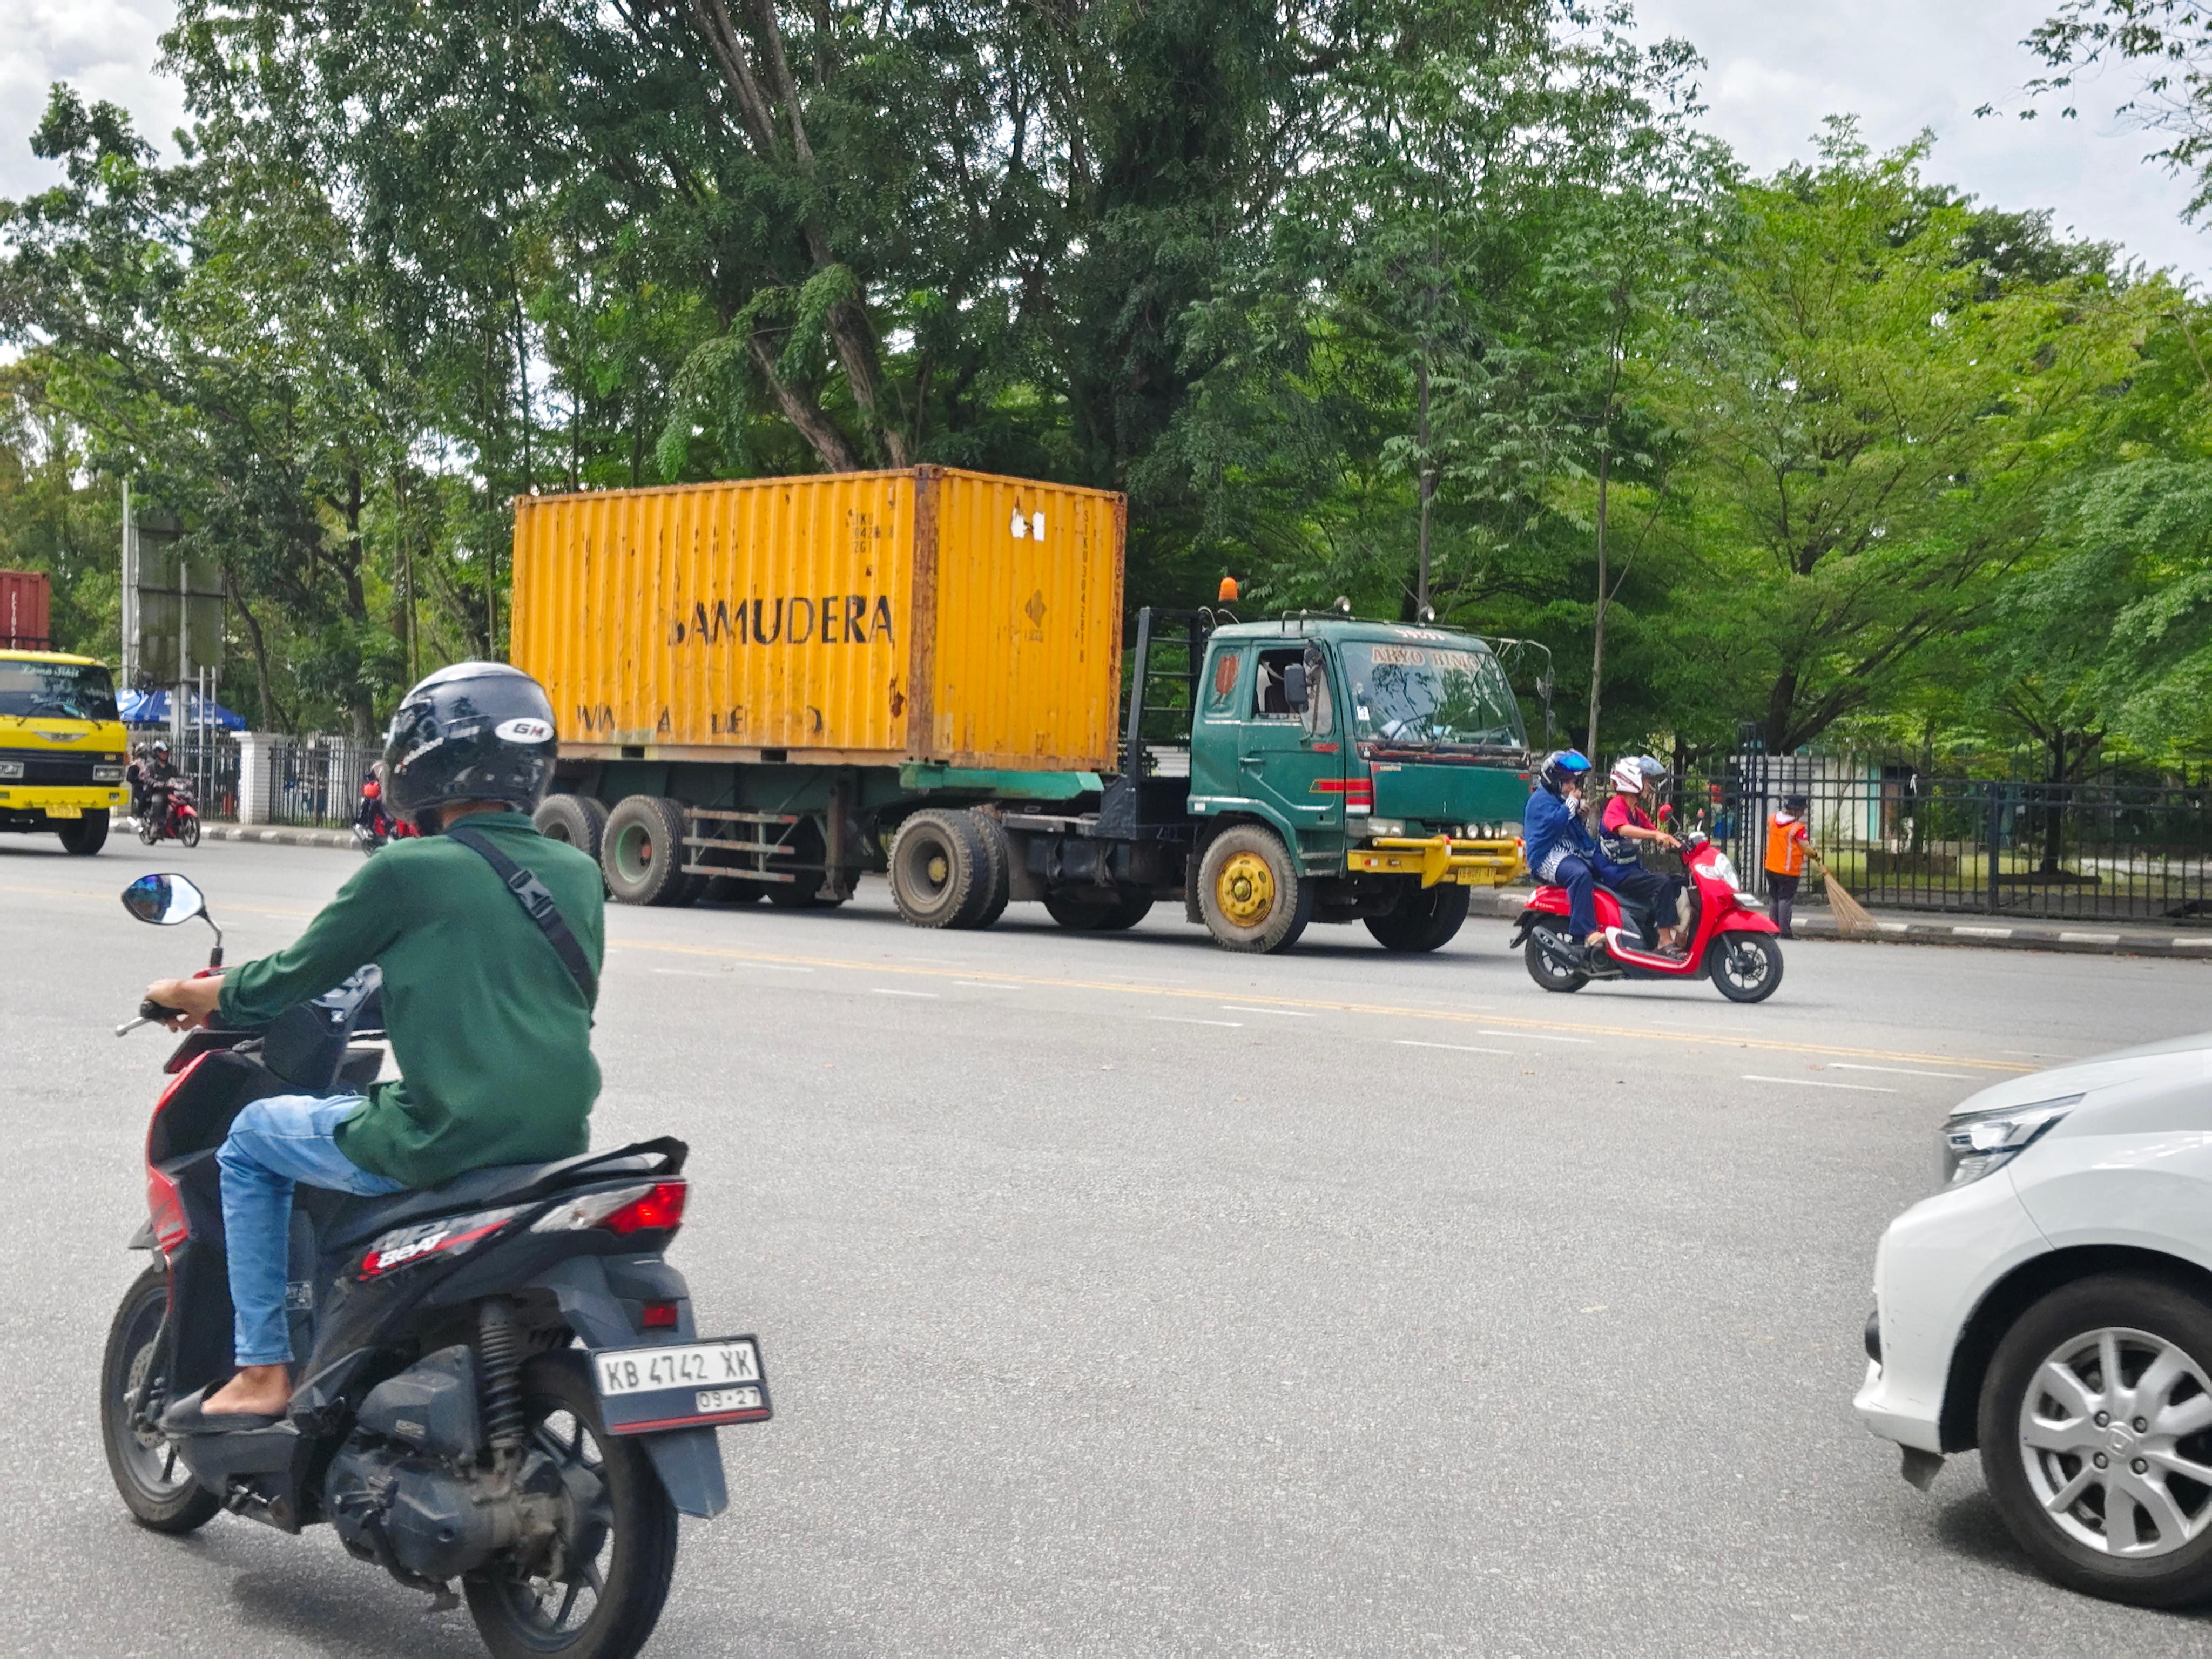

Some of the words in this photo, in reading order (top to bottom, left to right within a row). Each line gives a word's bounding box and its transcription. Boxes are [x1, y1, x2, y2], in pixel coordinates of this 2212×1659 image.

[512, 723, 544, 737] GM
[605, 1360, 639, 1391] KB
[649, 1353, 708, 1384] 4742
[719, 1350, 753, 1378] XK
